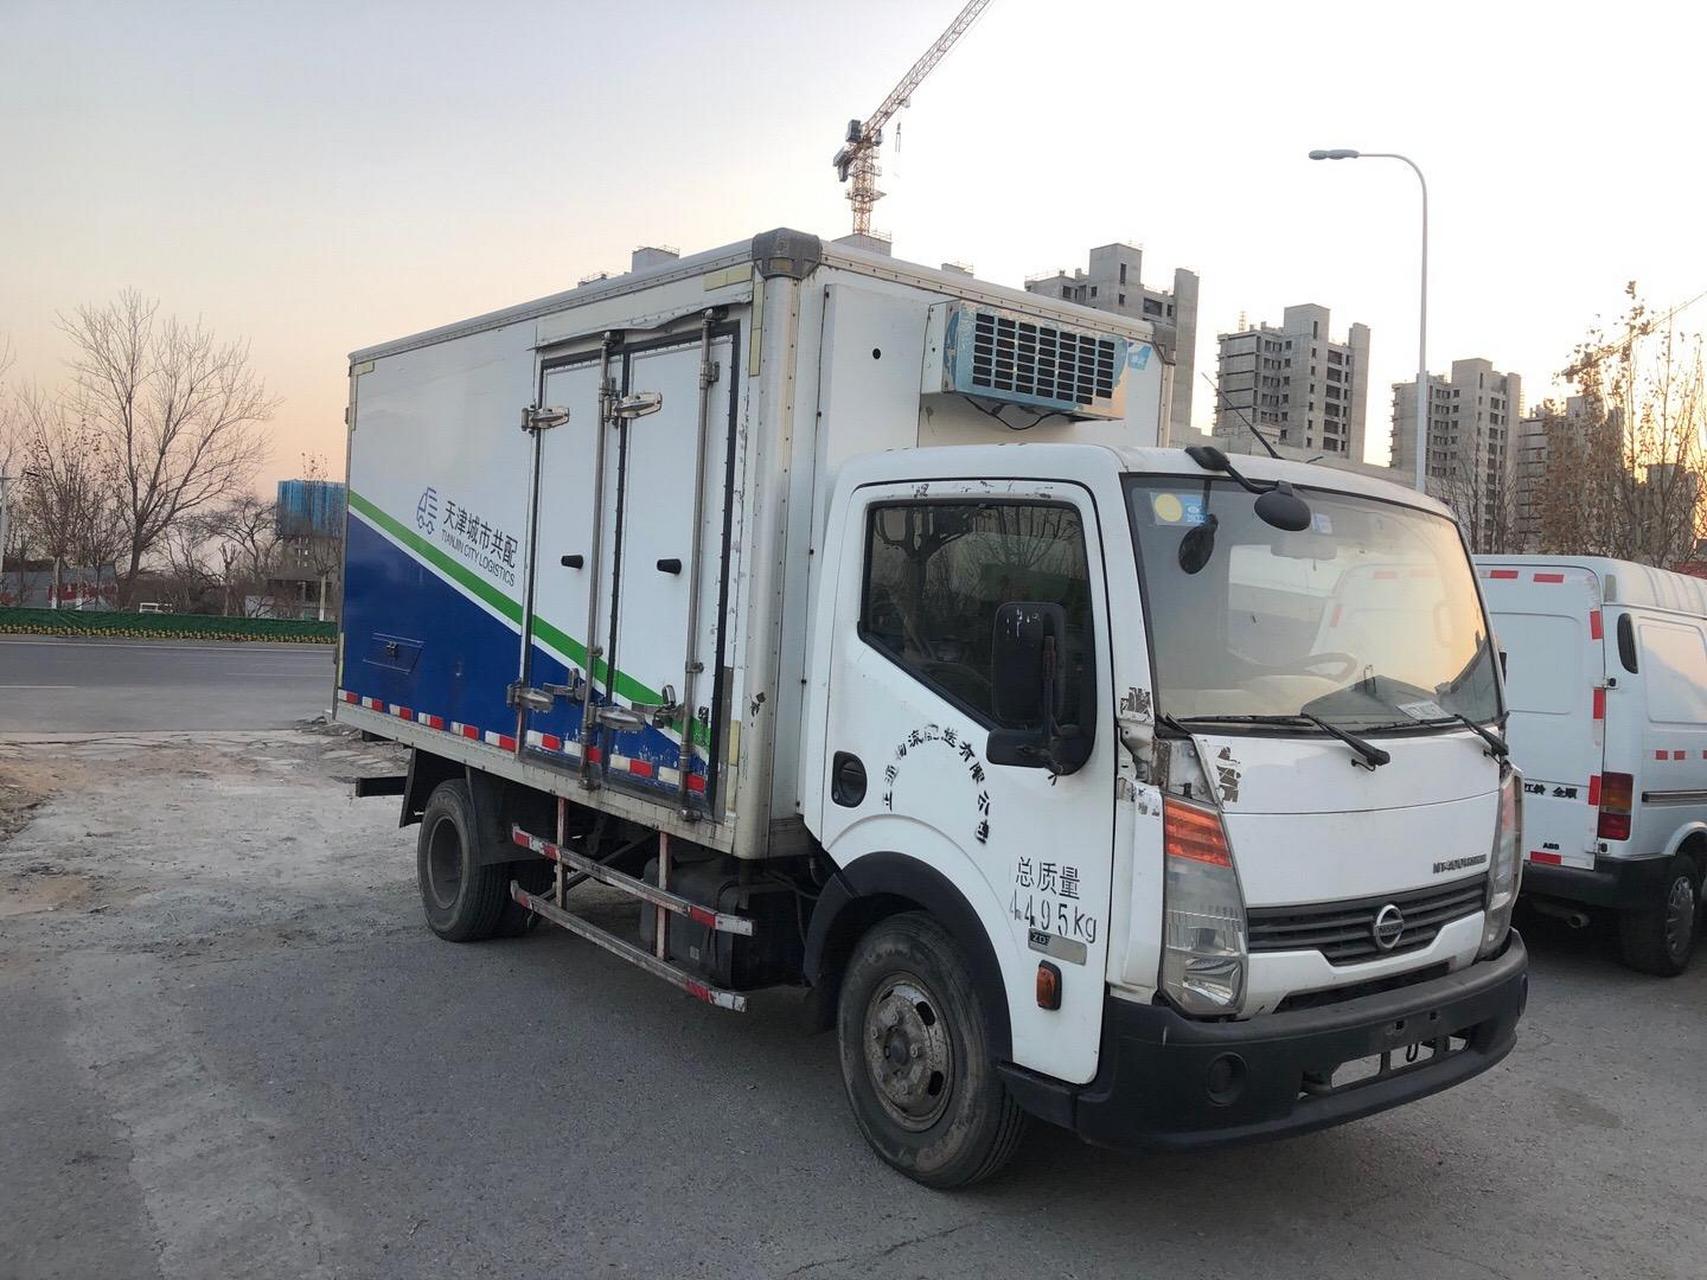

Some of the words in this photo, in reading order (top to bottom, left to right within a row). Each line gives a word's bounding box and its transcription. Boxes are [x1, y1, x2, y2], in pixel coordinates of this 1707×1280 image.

[443, 500, 518, 569] 天津城市共配
[463, 544, 480, 562] CITY
[478, 554, 516, 588] LOGISTICS
[1015, 856, 1081, 900] 总质量
